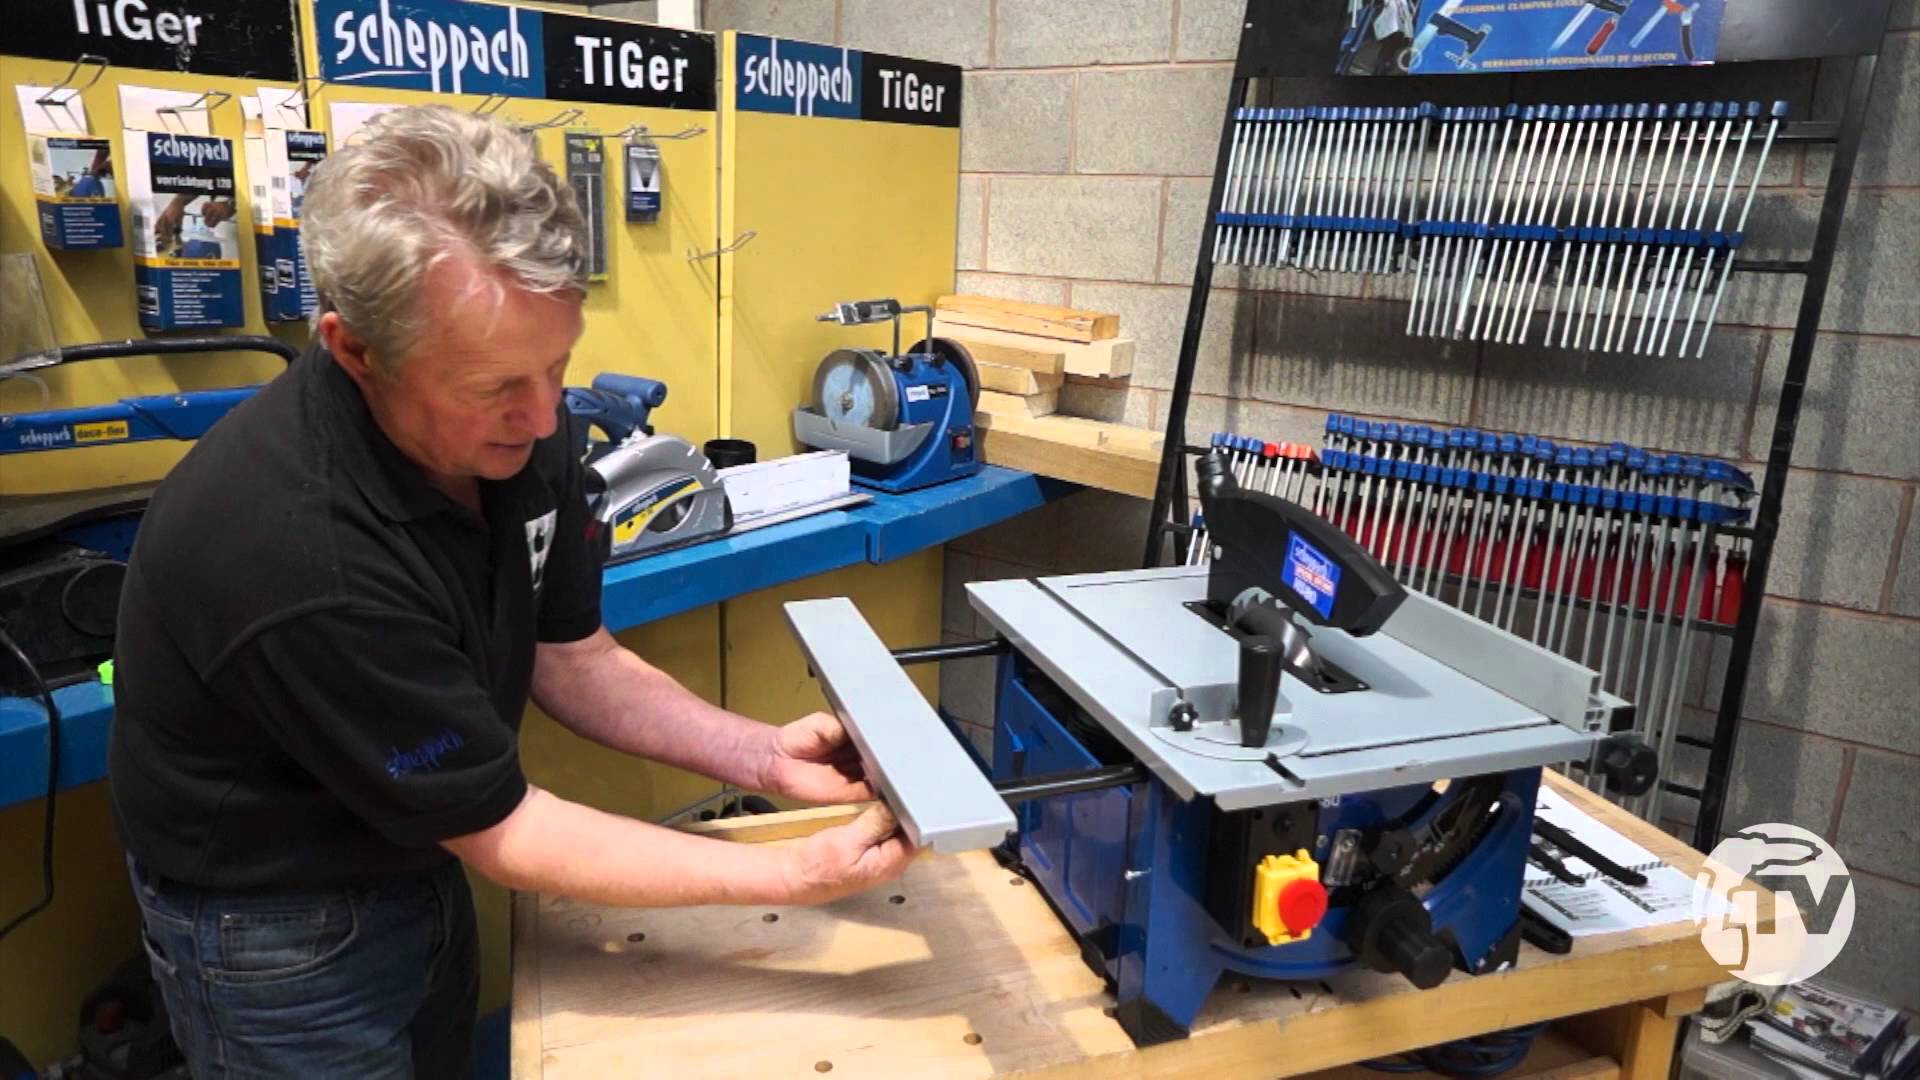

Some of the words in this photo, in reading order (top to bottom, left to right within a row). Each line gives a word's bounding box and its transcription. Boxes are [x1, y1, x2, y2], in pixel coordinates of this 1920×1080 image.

[334, 0, 529, 93] scheppach
[575, 36, 689, 92] TiGer
[744, 38, 852, 116] scheppach
[879, 69, 946, 112] TiGer
[154, 134, 229, 166] scheppach
[156, 174, 214, 190] vorrichtung
[20, 425, 71, 446] scheppach
